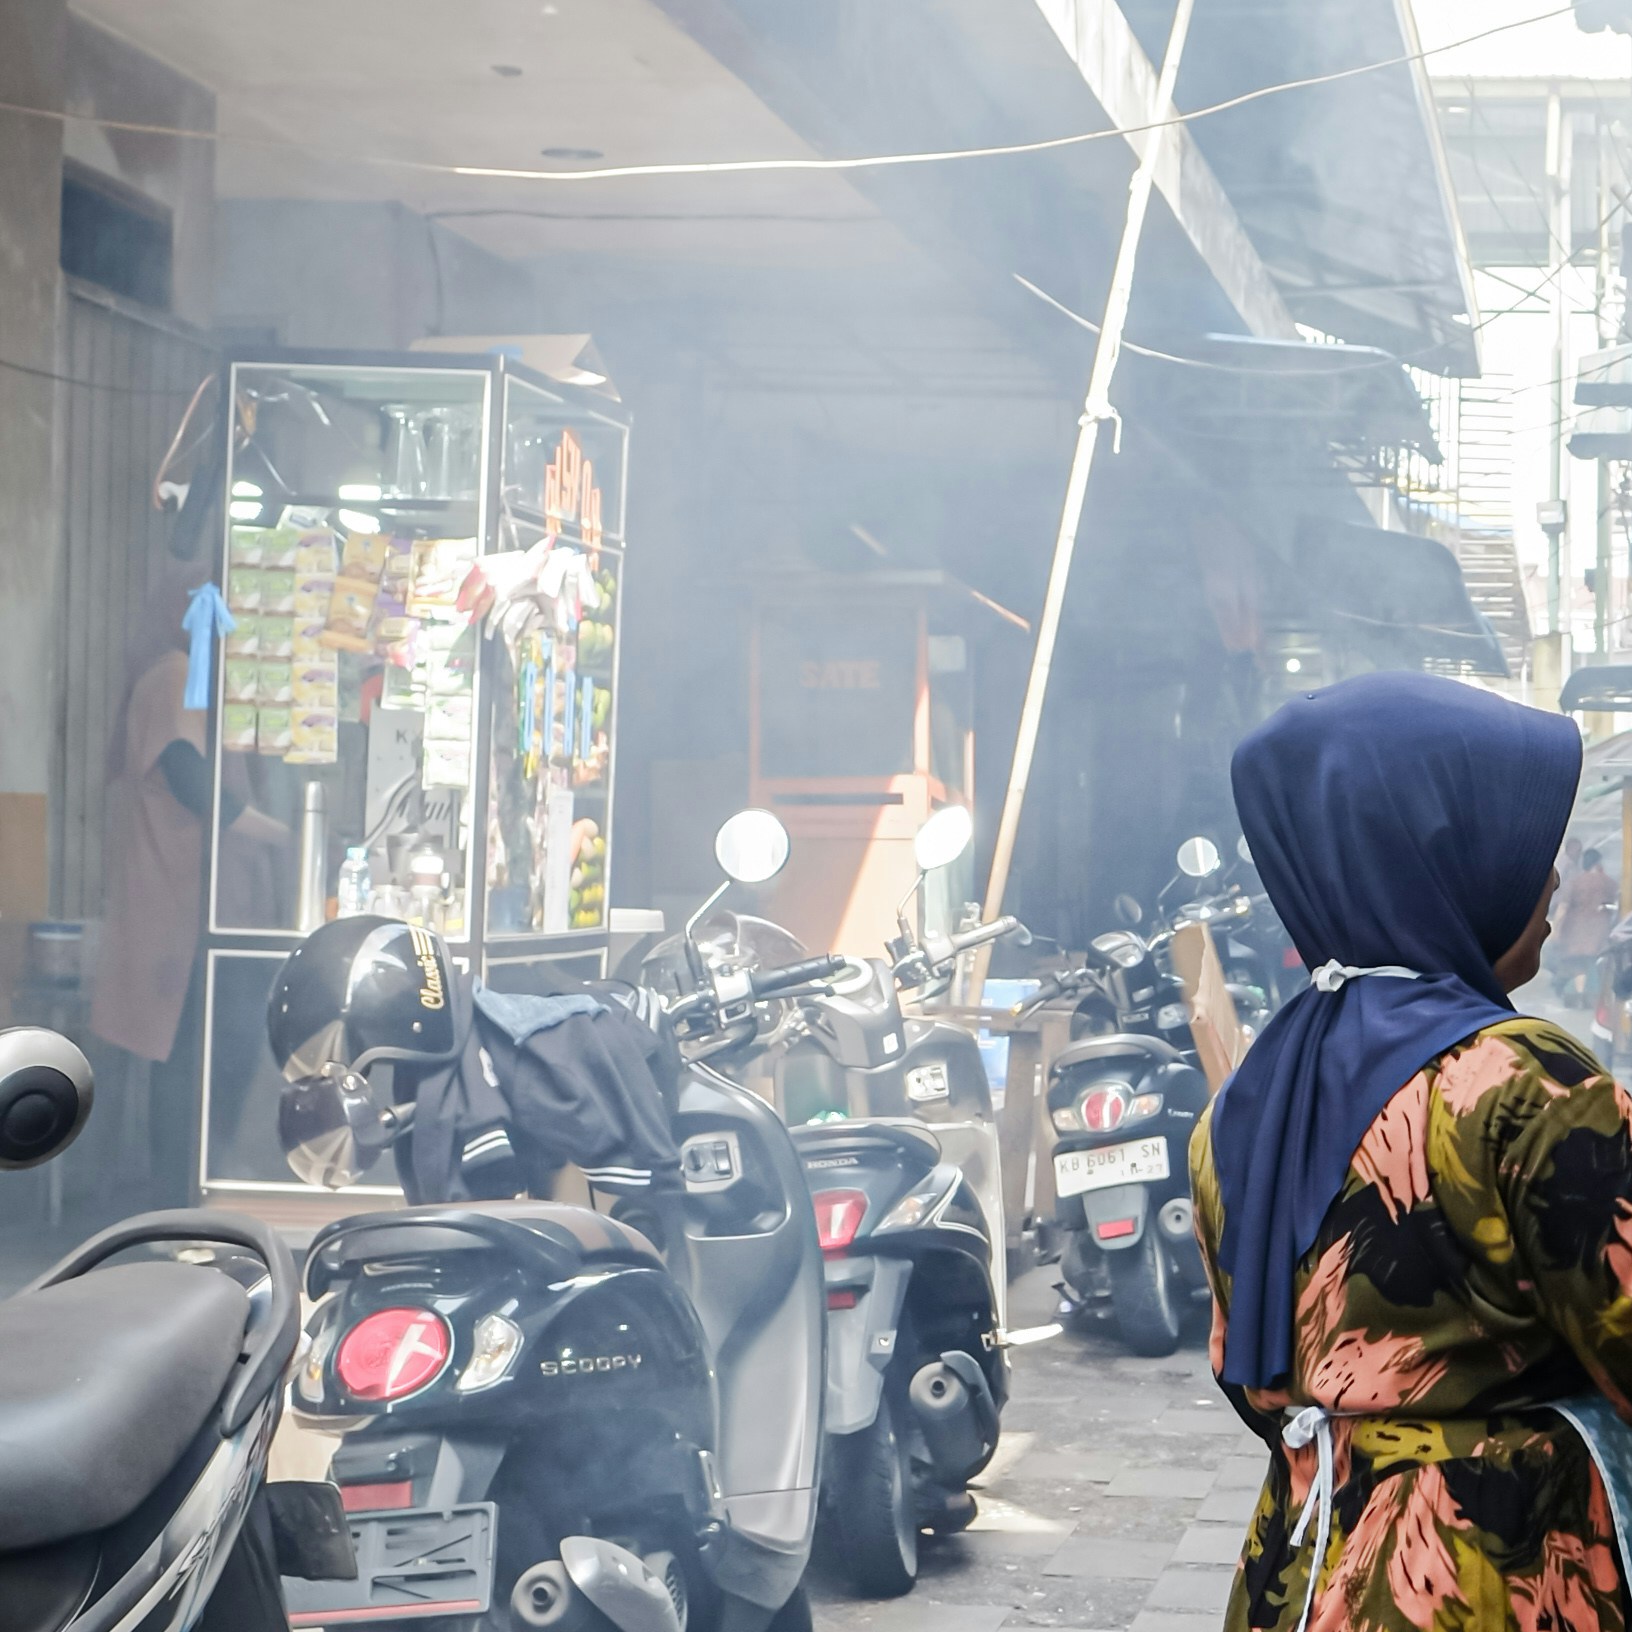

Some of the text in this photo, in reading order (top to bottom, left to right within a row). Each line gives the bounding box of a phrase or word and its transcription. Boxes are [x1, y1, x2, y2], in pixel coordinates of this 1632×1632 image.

[799, 660, 881, 688] SATE
[417, 955, 444, 1009] Classic
[1141, 1142, 1160, 1158] SN
[807, 1157, 859, 1169] HONDA
[540, 1353, 641, 1376] SCOOPY
